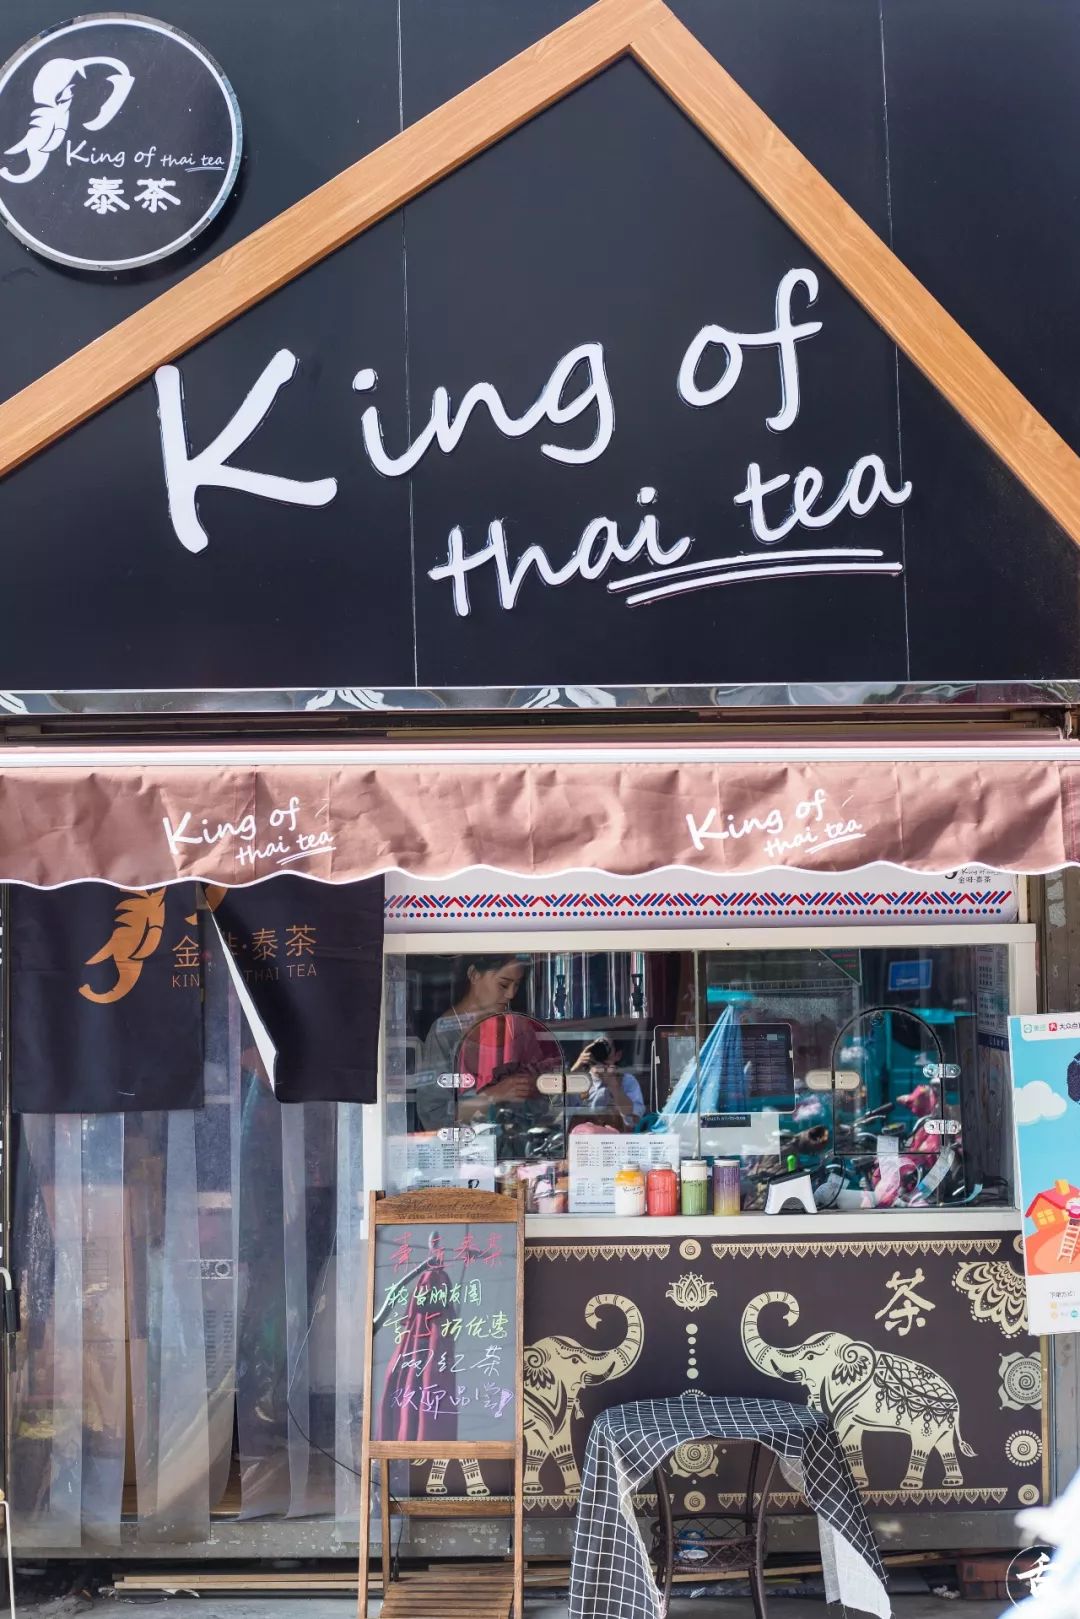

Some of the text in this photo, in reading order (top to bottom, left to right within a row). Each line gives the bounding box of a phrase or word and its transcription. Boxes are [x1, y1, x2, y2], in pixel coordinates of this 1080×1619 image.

[66, 140, 225, 168] King of thai tea
[84, 176, 182, 215] 泰茶
[154, 268, 823, 554] King of
[428, 454, 913, 617] thai tea
[162, 796, 300, 856] King of
[686, 788, 826, 850] King of
[763, 819, 863, 858] thai tea
[235, 831, 335, 866] thai tea
[286, 963, 318, 979] TEA
[875, 1267, 936, 1336] 茶
